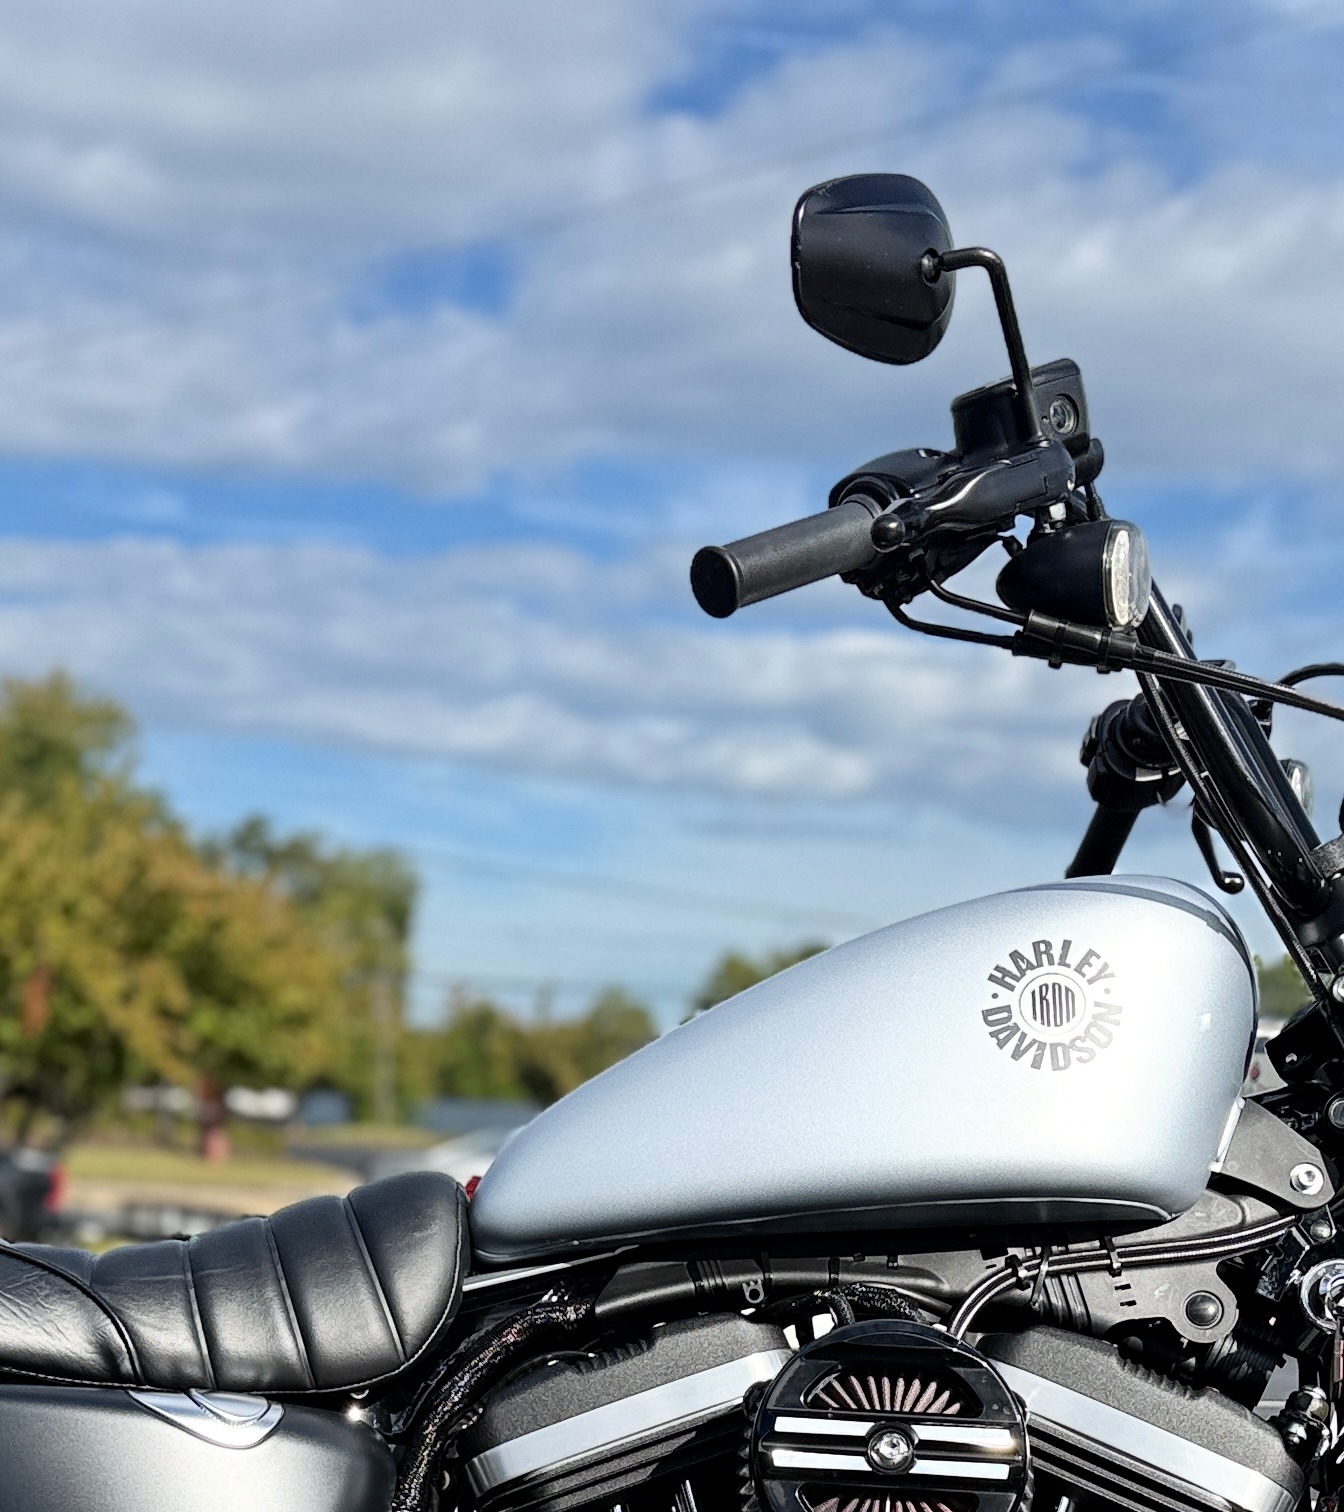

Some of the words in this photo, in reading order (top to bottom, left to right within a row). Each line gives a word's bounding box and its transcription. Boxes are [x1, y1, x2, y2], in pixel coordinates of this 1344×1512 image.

[987, 938, 1117, 993] HARLEY
[1030, 981, 1077, 1028] IRON
[981, 1000, 1123, 1072] DAVIDSON
